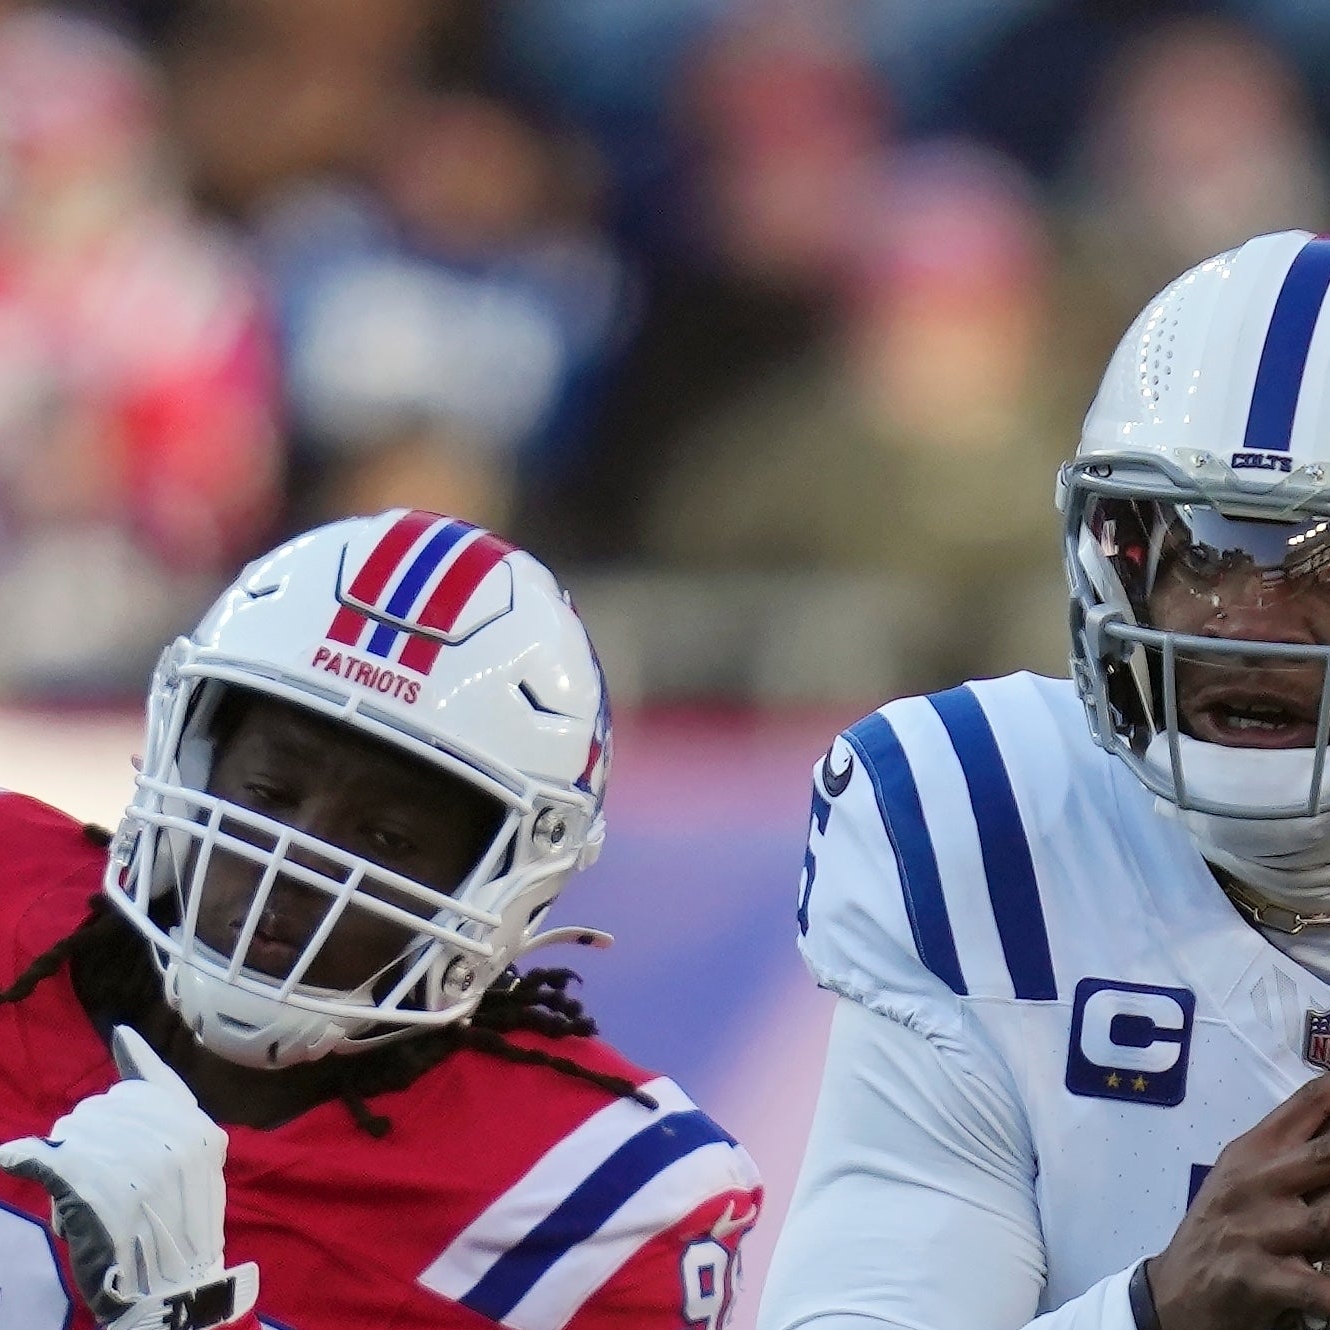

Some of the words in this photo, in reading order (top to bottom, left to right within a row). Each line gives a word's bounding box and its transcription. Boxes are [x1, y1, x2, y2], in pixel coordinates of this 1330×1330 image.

[1231, 453, 1293, 473] COLTS
[312, 645, 422, 705] PATRIOTS
[1080, 988, 1185, 1073] C
